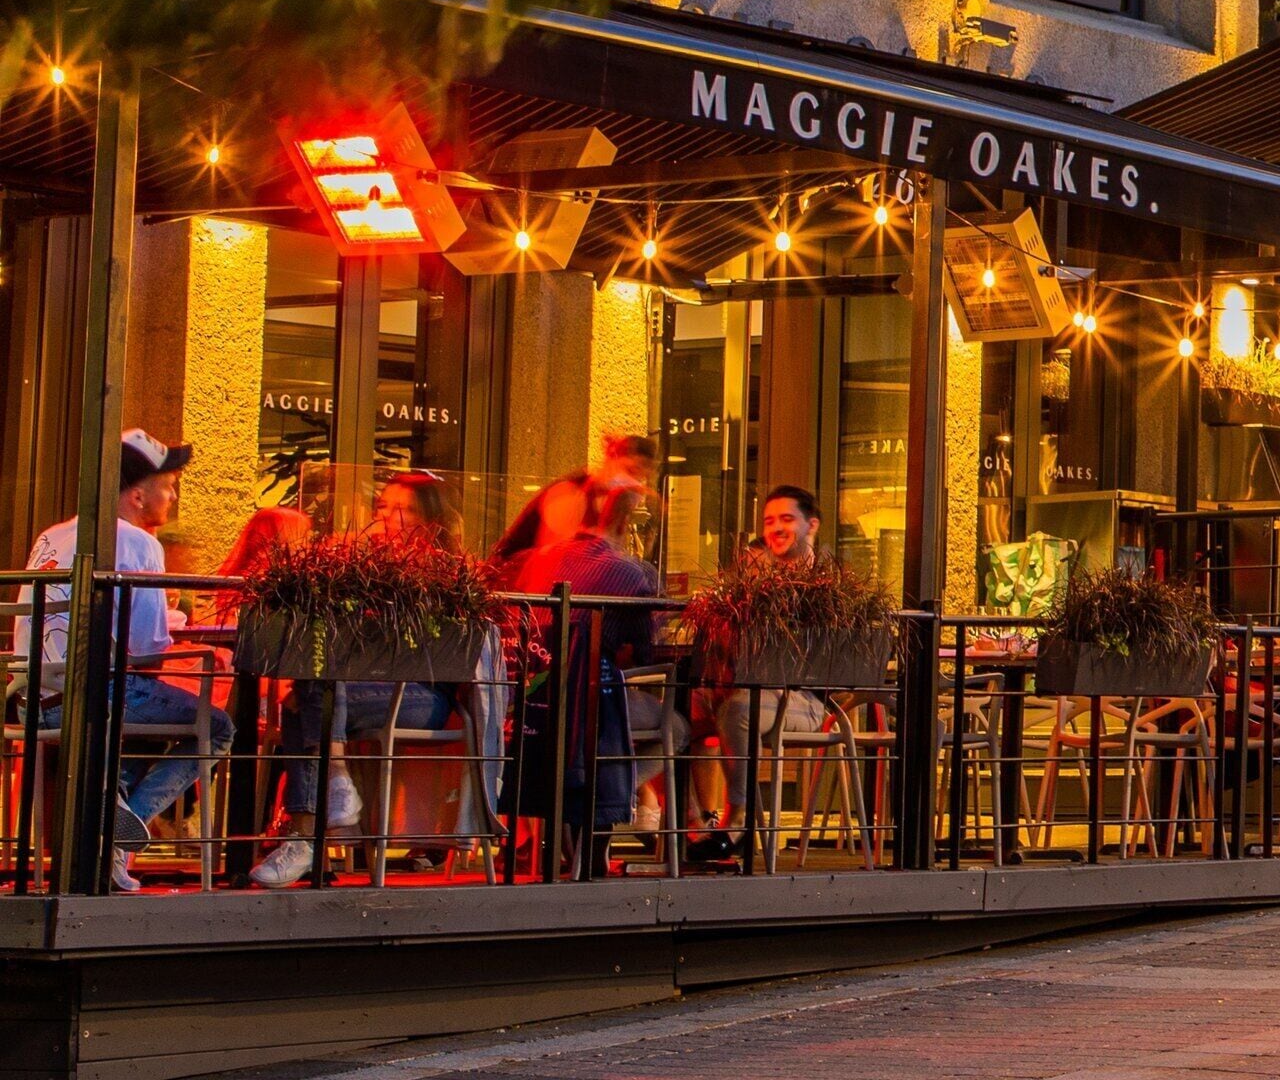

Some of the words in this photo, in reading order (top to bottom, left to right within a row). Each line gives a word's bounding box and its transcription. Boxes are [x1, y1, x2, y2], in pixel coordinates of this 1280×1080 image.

[691, 70, 933, 164] MAGGIE
[970, 131, 1159, 214] OAKES.
[264, 393, 333, 414] AGGIE
[383, 402, 458, 425] OAKES.
[1046, 465, 1098, 481] OAKES.
